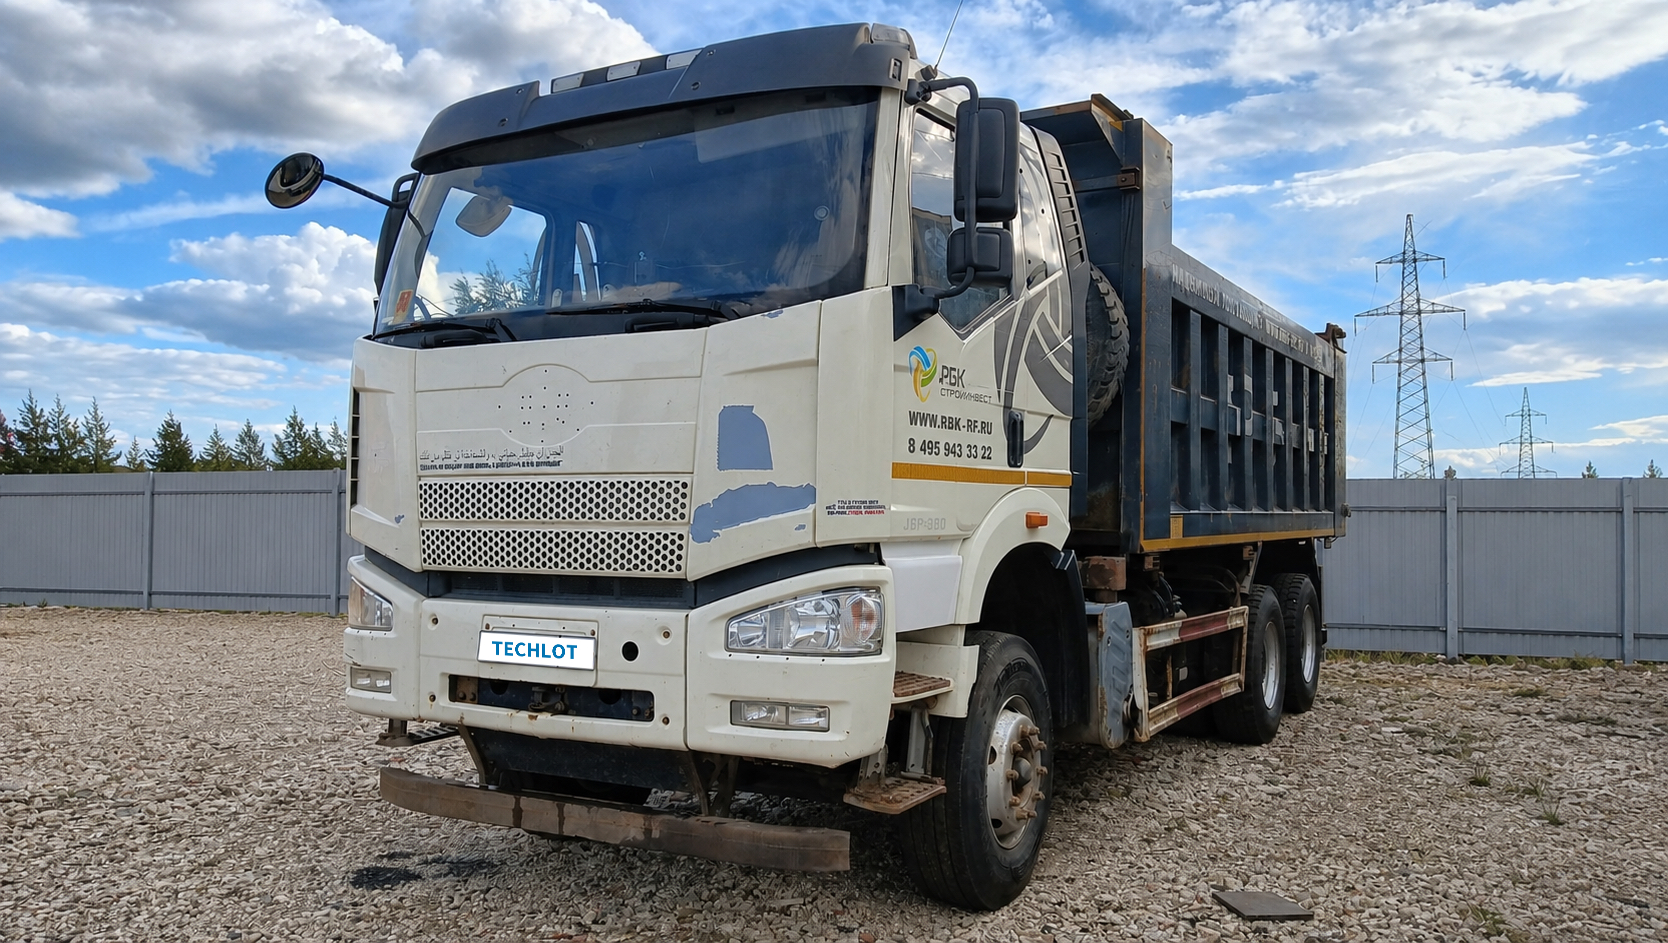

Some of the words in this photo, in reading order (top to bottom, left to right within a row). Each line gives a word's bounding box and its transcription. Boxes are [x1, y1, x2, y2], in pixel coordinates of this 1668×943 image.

[908, 410, 993, 435] WWW.RBK-RF.RU
[908, 437, 916, 454] 8
[920, 439, 940, 456] 495
[944, 442, 963, 458] 943
[966, 444, 978, 459] 33
[981, 445, 992, 460] 22
